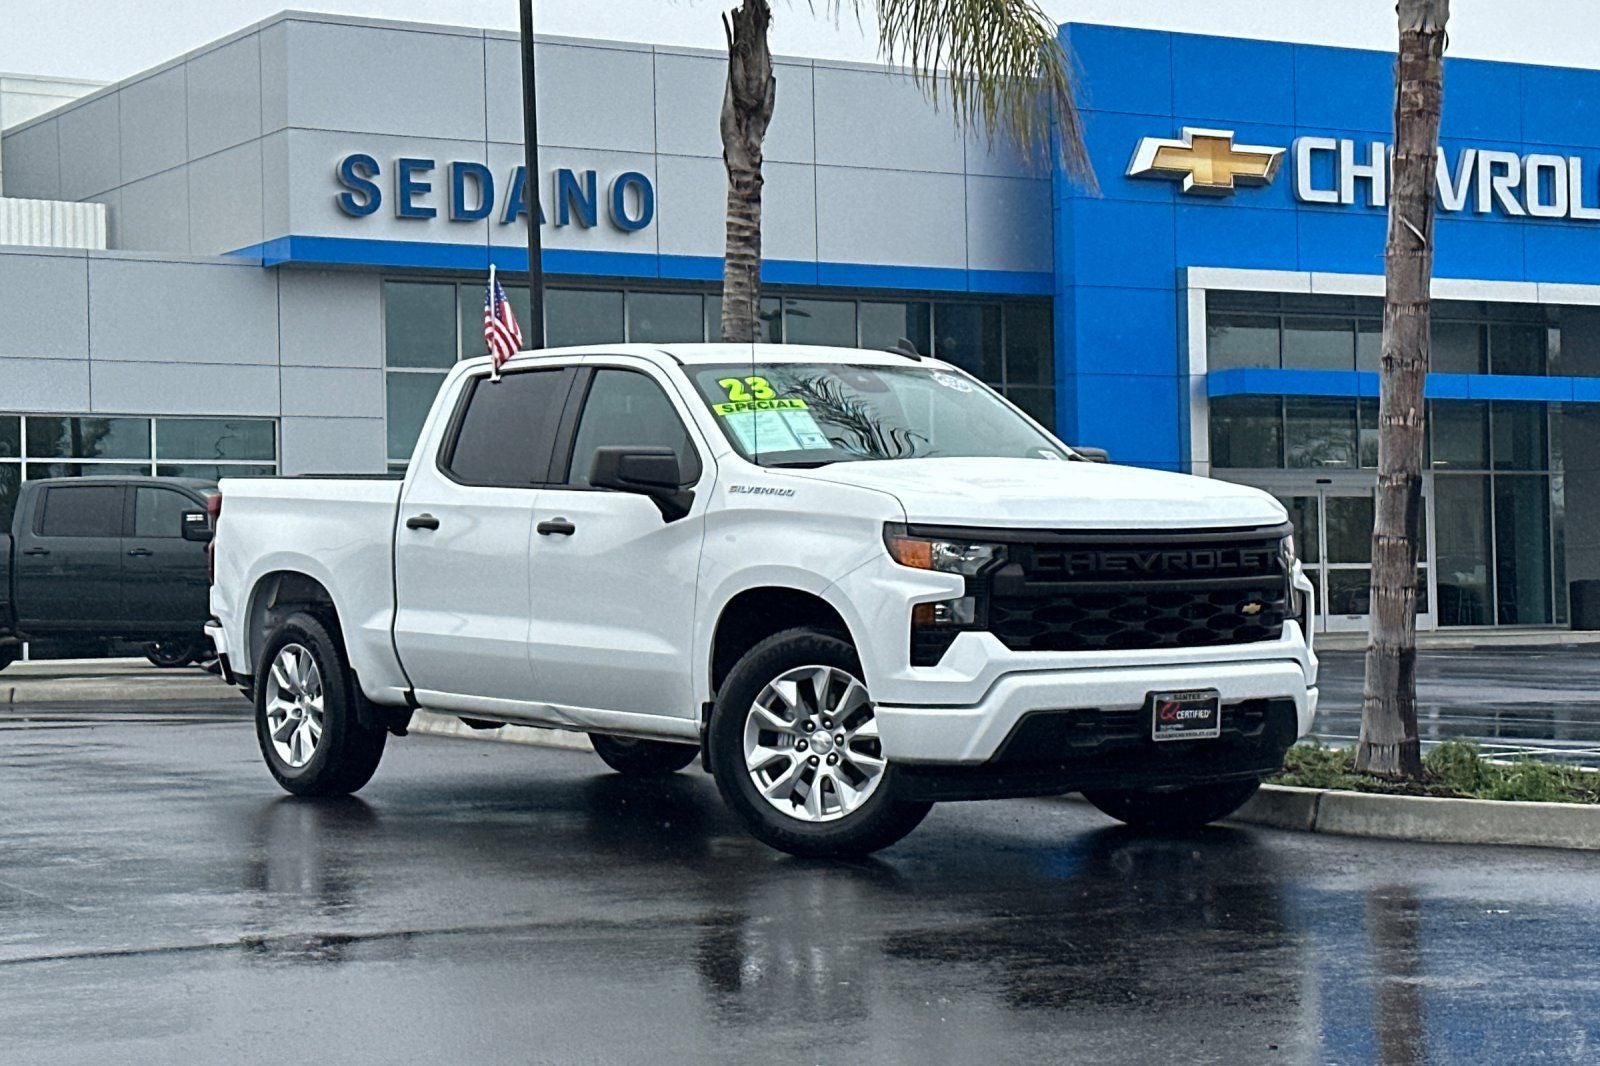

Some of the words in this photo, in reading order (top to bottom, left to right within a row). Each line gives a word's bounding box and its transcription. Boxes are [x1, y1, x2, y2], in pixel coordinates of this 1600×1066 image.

[1293, 136, 1600, 220] CHVROL
[336, 153, 655, 232] SEDANO
[718, 377, 776, 402] 23
[722, 400, 801, 413] SPECIAL
[728, 485, 796, 497] SILVERADO
[1031, 549, 1281, 571] CHEVROLET
[1176, 709, 1210, 720] CERTIFIED
